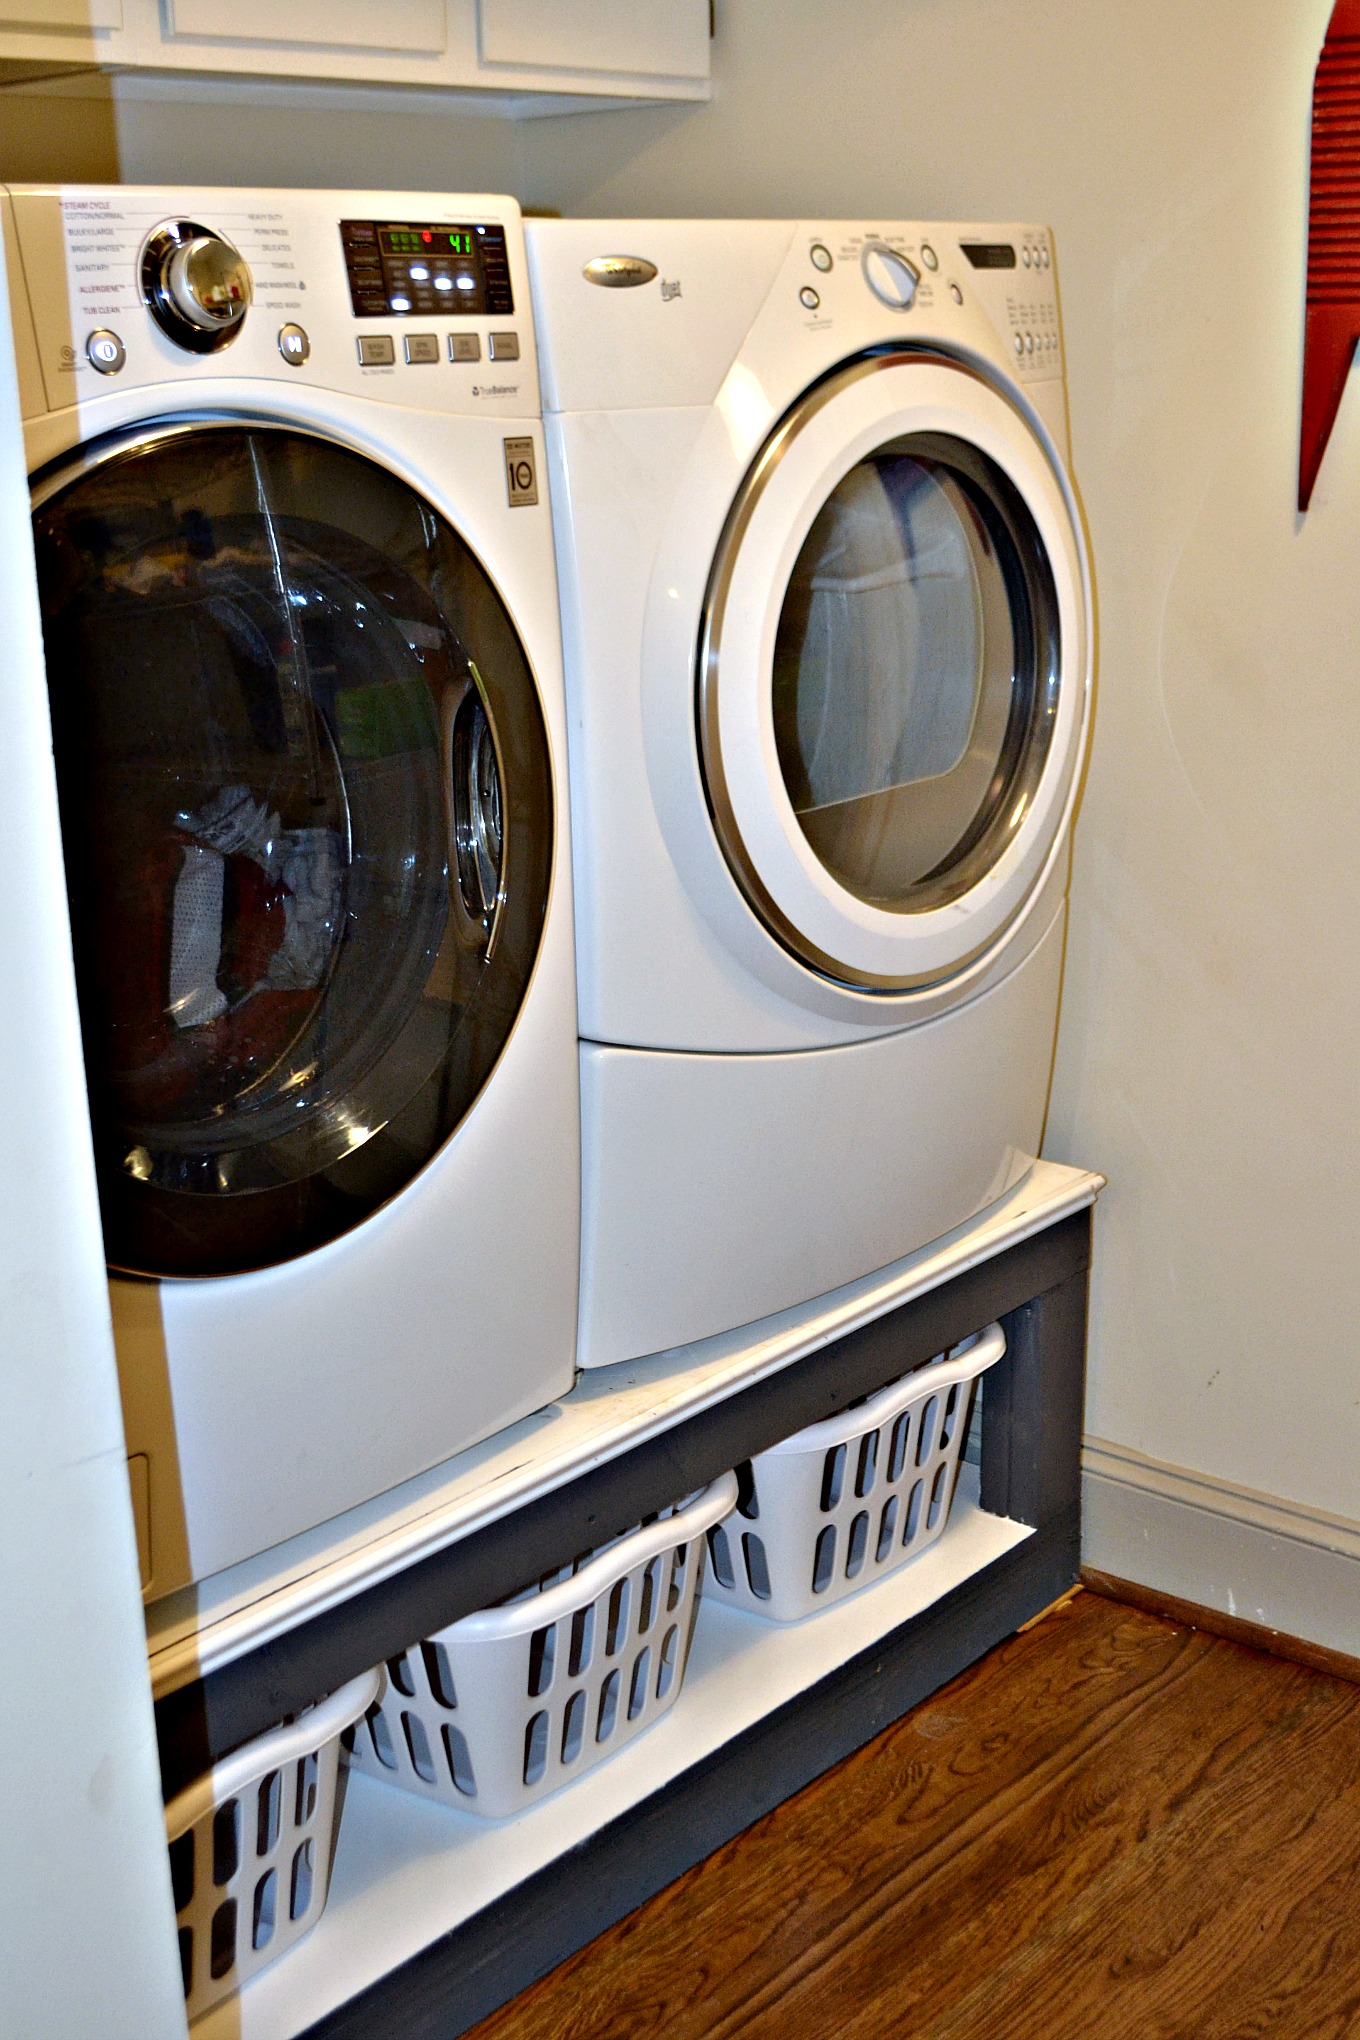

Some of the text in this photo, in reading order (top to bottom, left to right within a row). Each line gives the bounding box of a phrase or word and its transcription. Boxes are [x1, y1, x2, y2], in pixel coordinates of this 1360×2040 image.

[64, 201, 112, 210] STEAM CYCLE
[449, 233, 471, 253] 41
[99, 305, 121, 314] CLEAN
